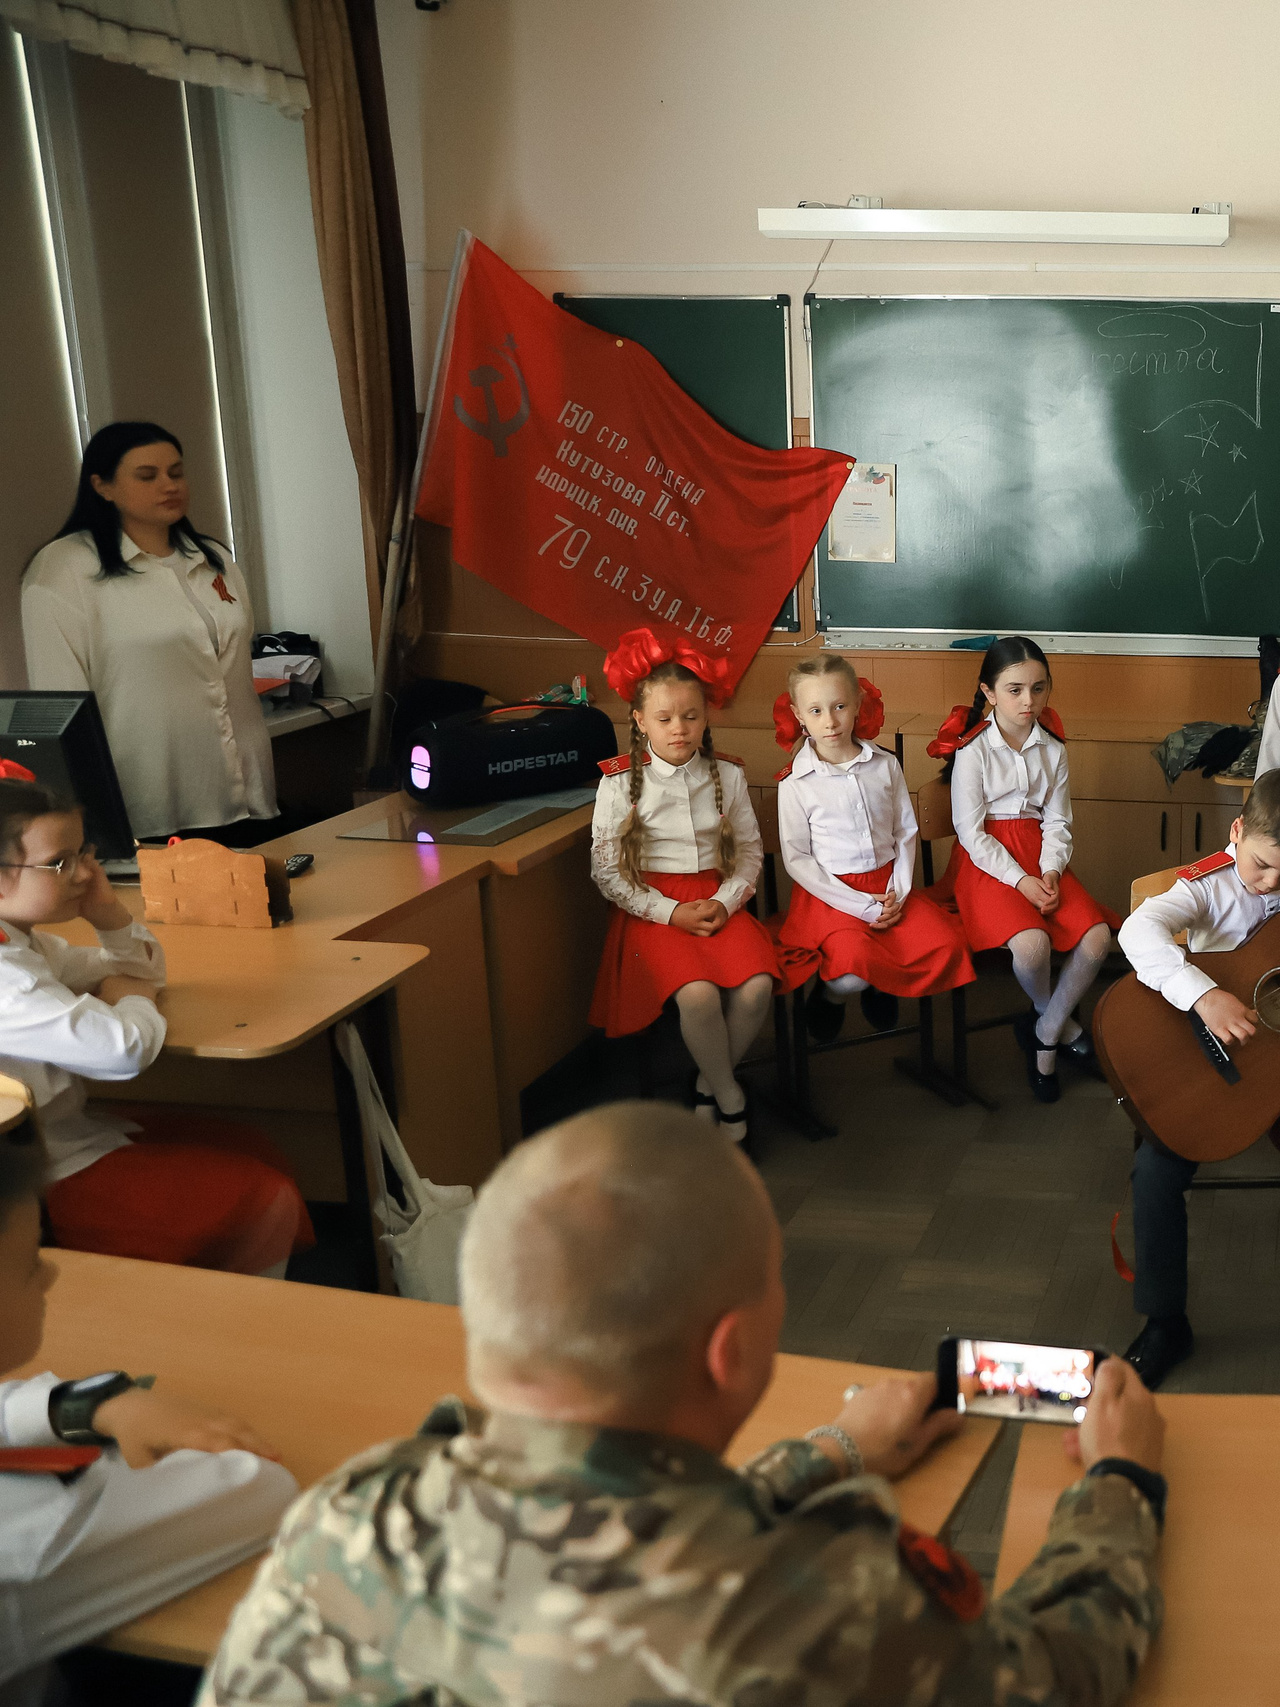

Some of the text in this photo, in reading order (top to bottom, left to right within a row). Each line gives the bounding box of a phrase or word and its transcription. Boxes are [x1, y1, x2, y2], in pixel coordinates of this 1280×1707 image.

[557, 400, 594, 435] 150
[538, 513, 592, 570] 79
[488, 749, 579, 776] HOPESTAR
